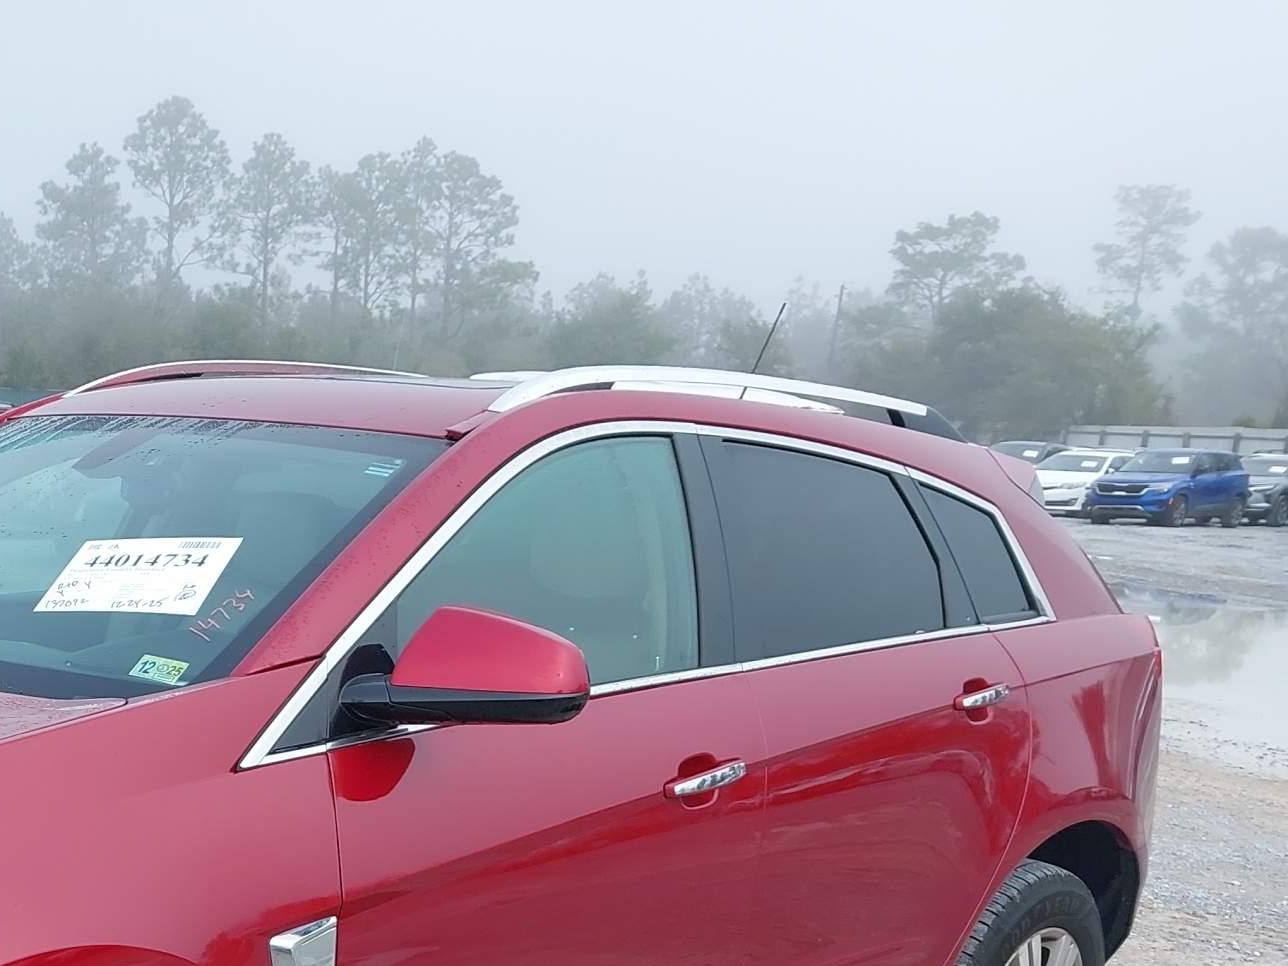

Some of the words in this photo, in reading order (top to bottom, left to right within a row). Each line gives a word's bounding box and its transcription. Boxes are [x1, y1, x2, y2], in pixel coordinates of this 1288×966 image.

[83, 553, 209, 567] 44014734
[189, 589, 255, 641] 14734
[138, 660, 156, 674] 12
[166, 665, 184, 677] 25
